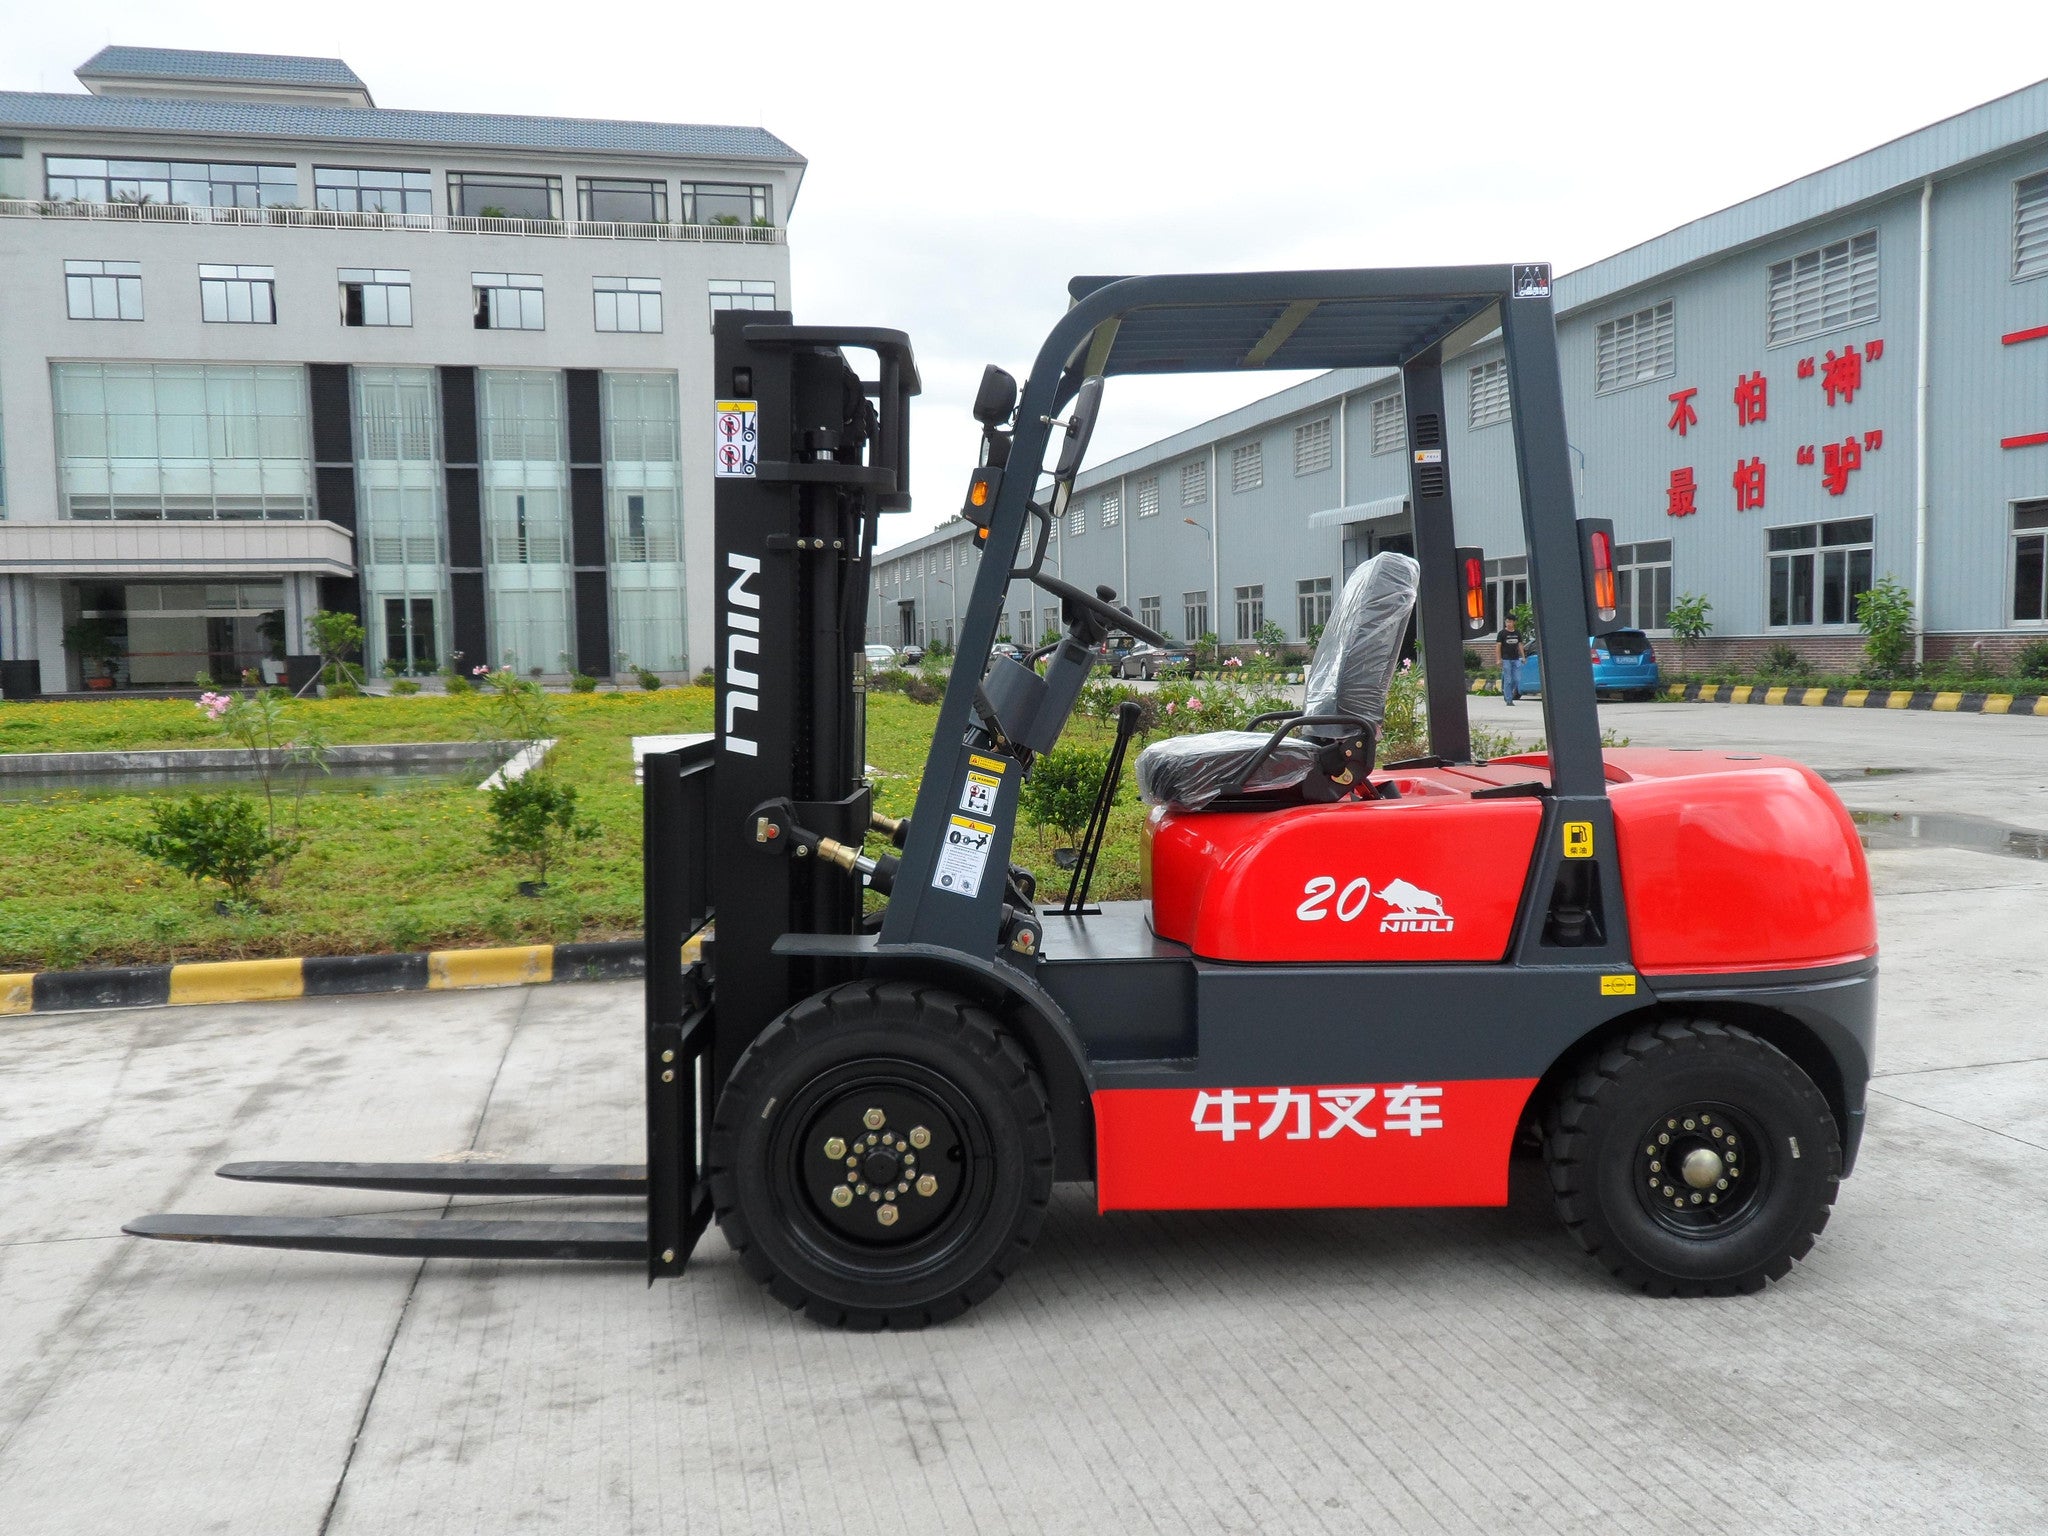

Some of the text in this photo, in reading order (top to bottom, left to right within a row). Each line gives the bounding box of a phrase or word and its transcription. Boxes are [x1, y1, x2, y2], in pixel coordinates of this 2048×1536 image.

[725, 552, 761, 757] NIULI
[1296, 876, 1371, 922] 20
[1379, 920, 1454, 933] NIULI
[1190, 1084, 1443, 1142] 牛力叉车
